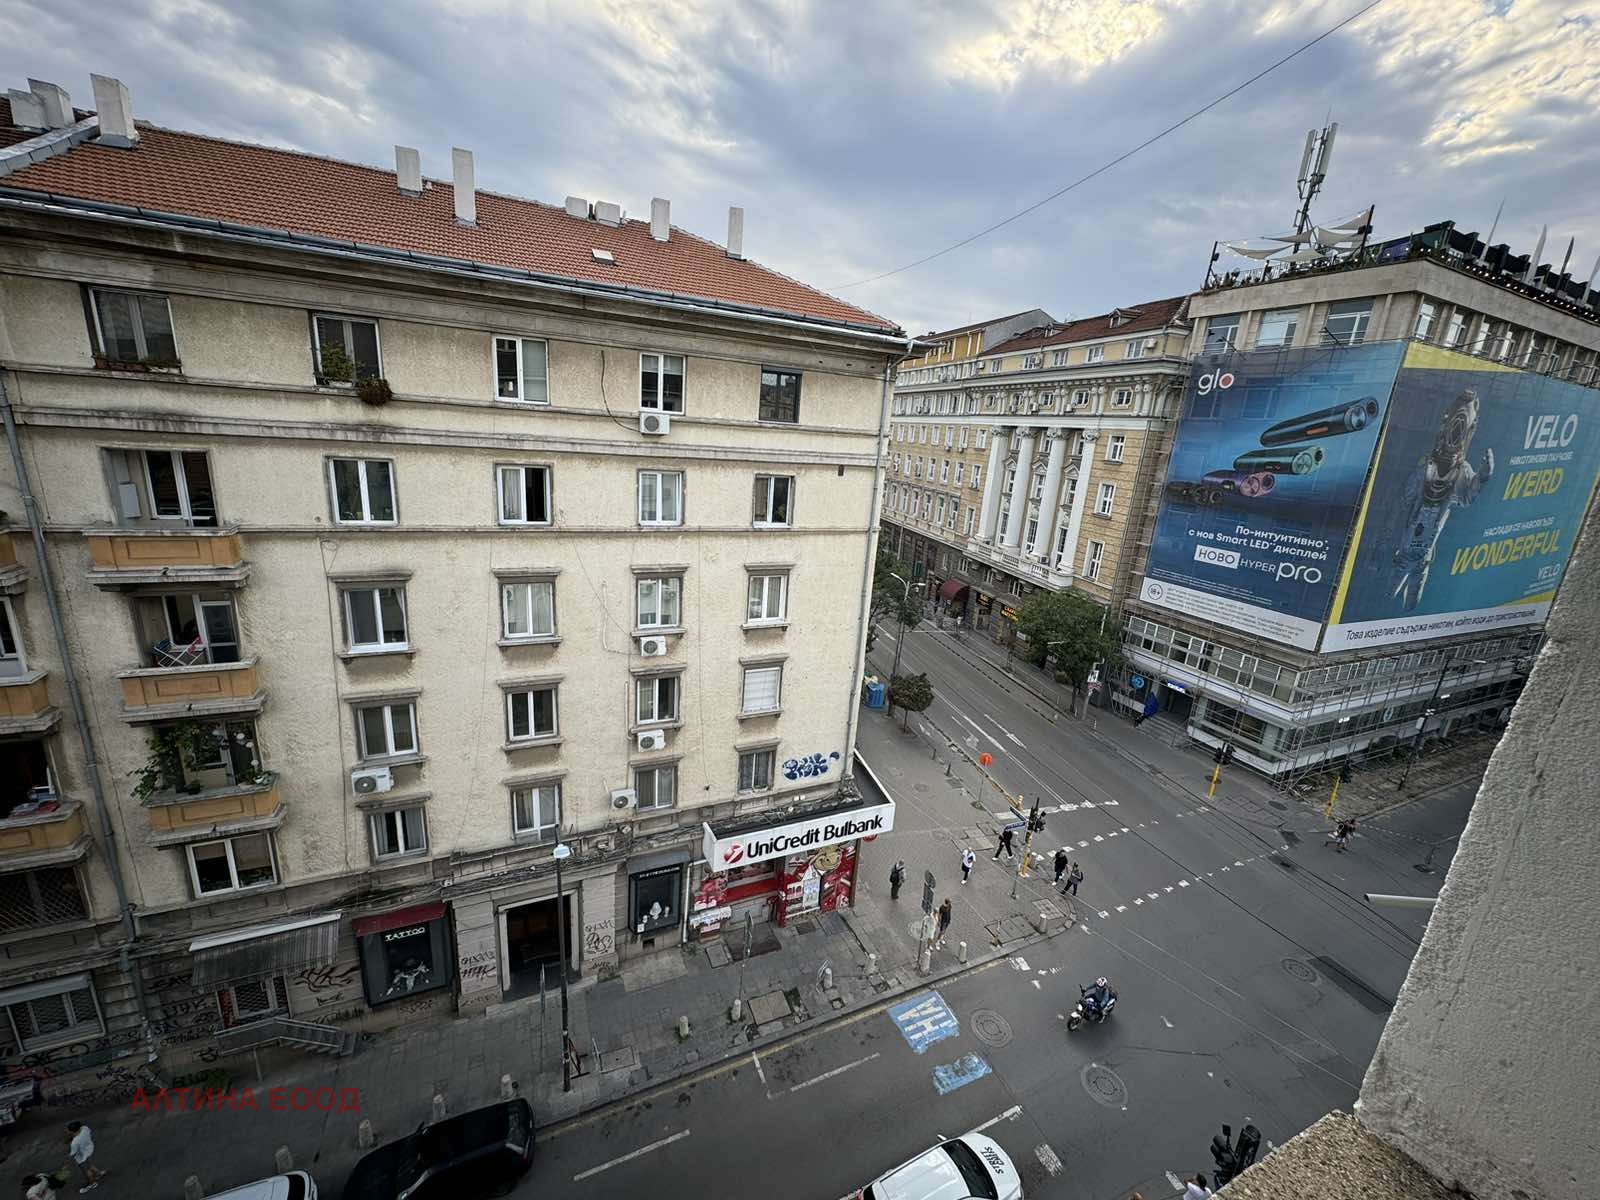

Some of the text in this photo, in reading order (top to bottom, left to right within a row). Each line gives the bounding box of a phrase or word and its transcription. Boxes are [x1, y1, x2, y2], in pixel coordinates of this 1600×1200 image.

[1198, 367, 1235, 395] glo
[1523, 414, 1579, 449] VELO
[1503, 467, 1565, 500] WEIRD
[1188, 528, 1195, 536] с
[1199, 530, 1215, 540] нов
[1216, 532, 1248, 547] Smart
[1274, 545, 1328, 562] дисплей
[1450, 529, 1561, 576] WONDERFUL
[1239, 557, 1277, 574] HYPER
[1275, 562, 1323, 585] pro
[1536, 563, 1561, 580] VELO
[1346, 629, 1364, 641] Това
[1364, 626, 1396, 639] изделие
[1395, 623, 1428, 636] съдържа
[747, 814, 883, 858] UniCredit Bulbank
[385, 926, 426, 941] TATTOO
